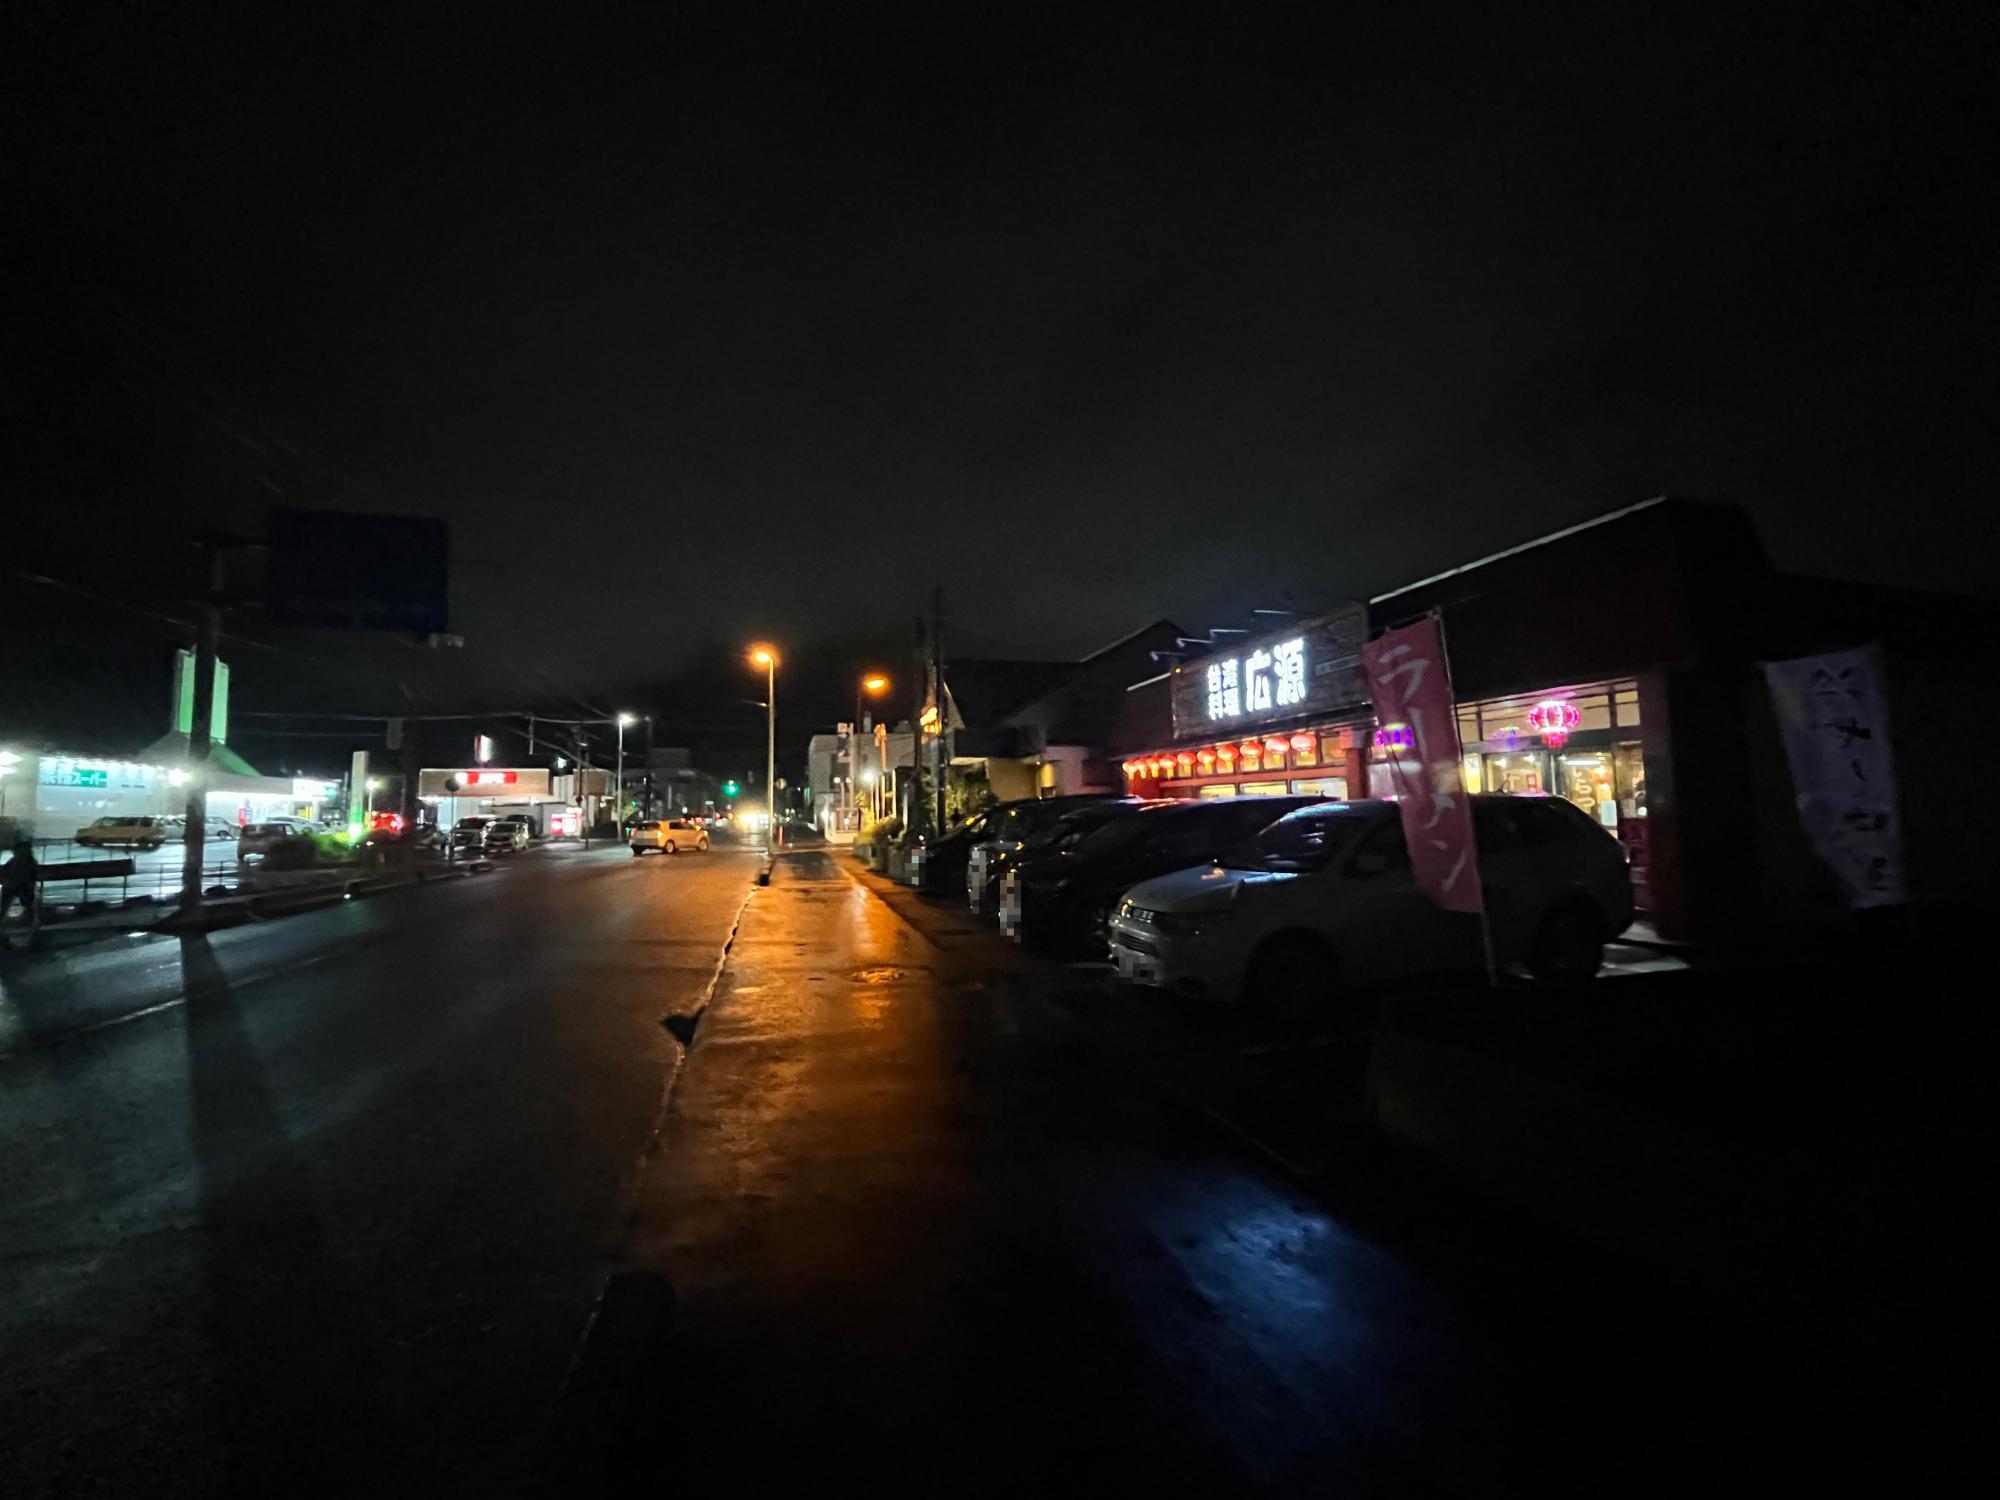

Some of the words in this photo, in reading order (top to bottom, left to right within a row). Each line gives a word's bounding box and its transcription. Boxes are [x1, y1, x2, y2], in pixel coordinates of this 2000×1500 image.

[1245, 637, 1306, 712] 広源
[1377, 644, 1467, 892] ラーメン
